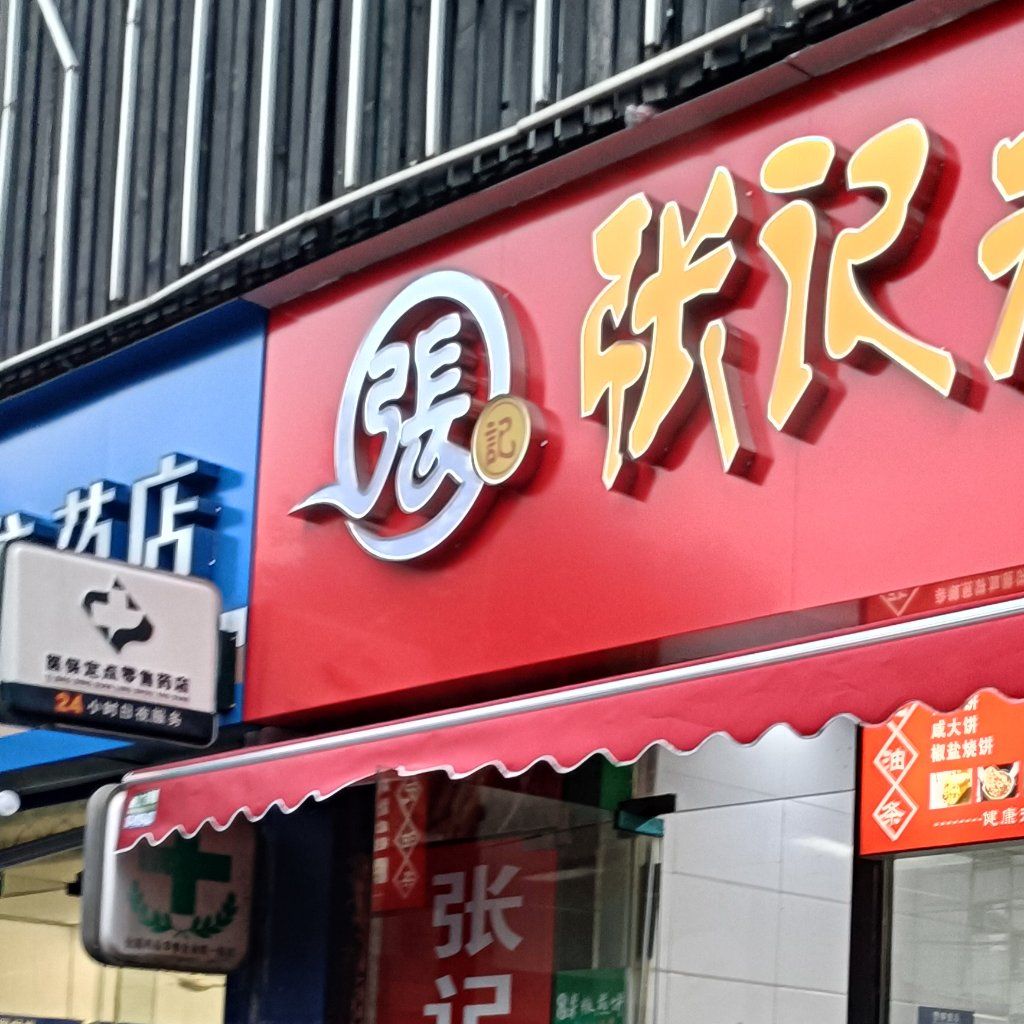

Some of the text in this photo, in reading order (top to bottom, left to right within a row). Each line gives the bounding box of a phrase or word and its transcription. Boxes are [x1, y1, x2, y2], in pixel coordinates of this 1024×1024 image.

[54, 691, 84, 715] 24
[930, 736, 994, 763] 椒盐烧饼
